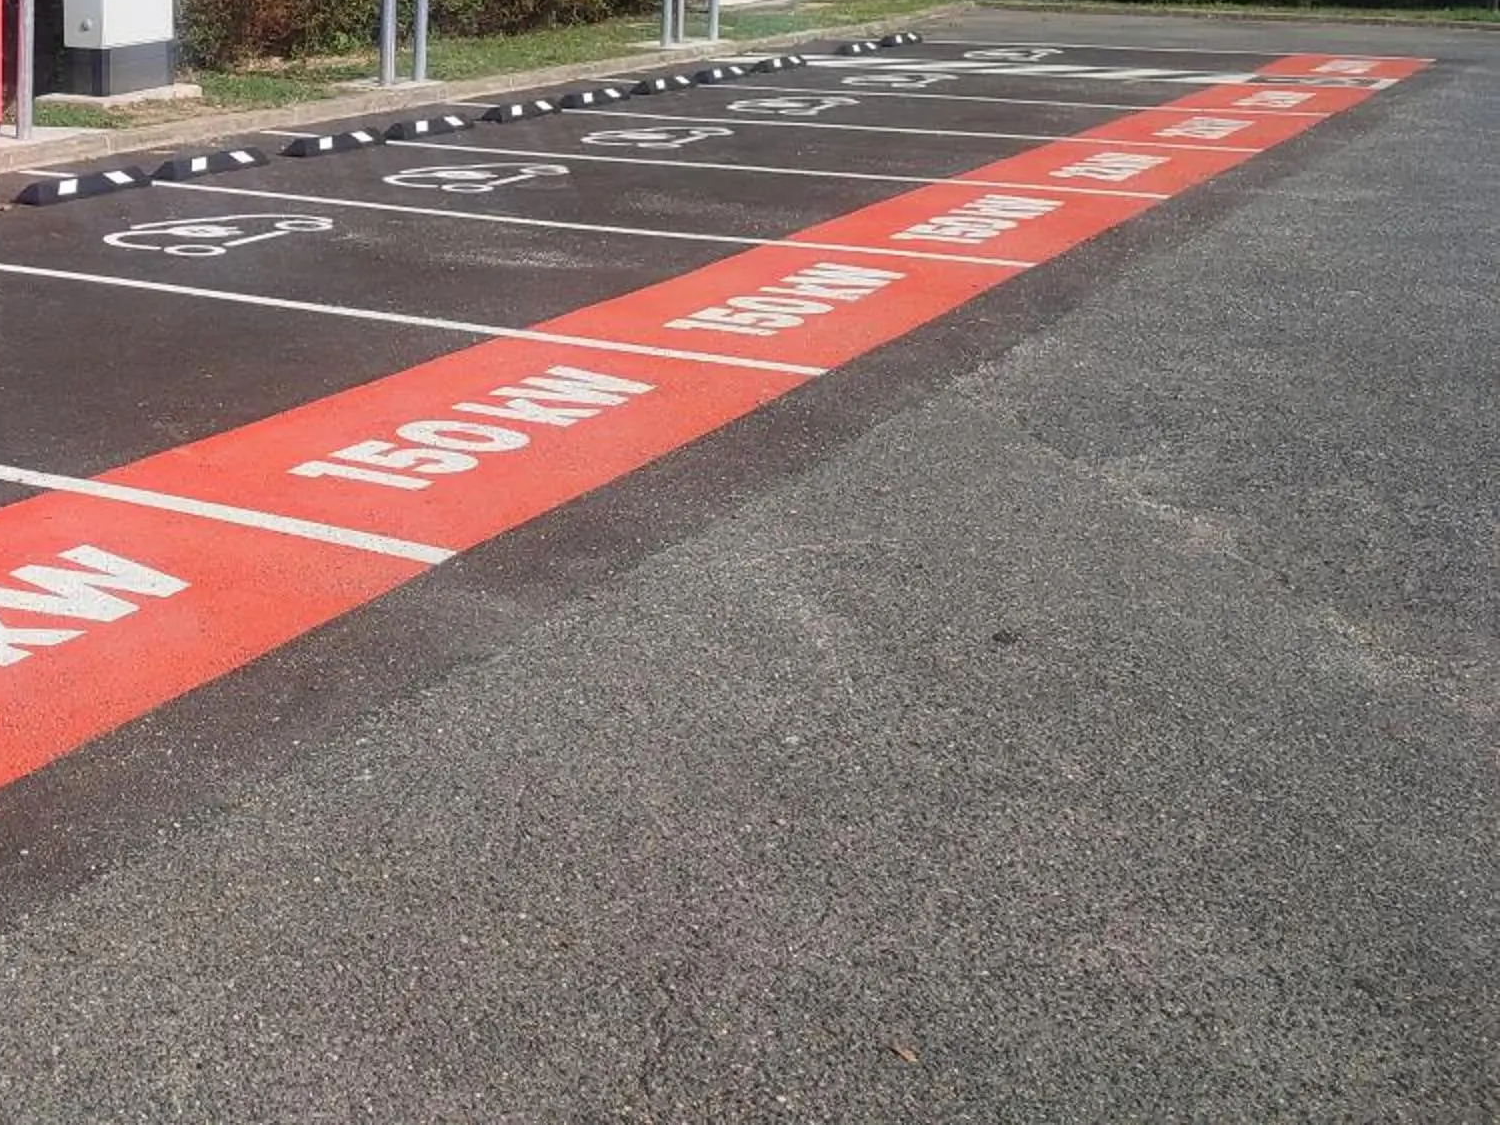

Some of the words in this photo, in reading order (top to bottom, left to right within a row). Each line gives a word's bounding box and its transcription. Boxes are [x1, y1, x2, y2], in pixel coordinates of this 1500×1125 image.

[663, 295, 836, 337] 150
[757, 262, 907, 303] kW
[287, 419, 531, 492] 150
[451, 364, 657, 428] kW
